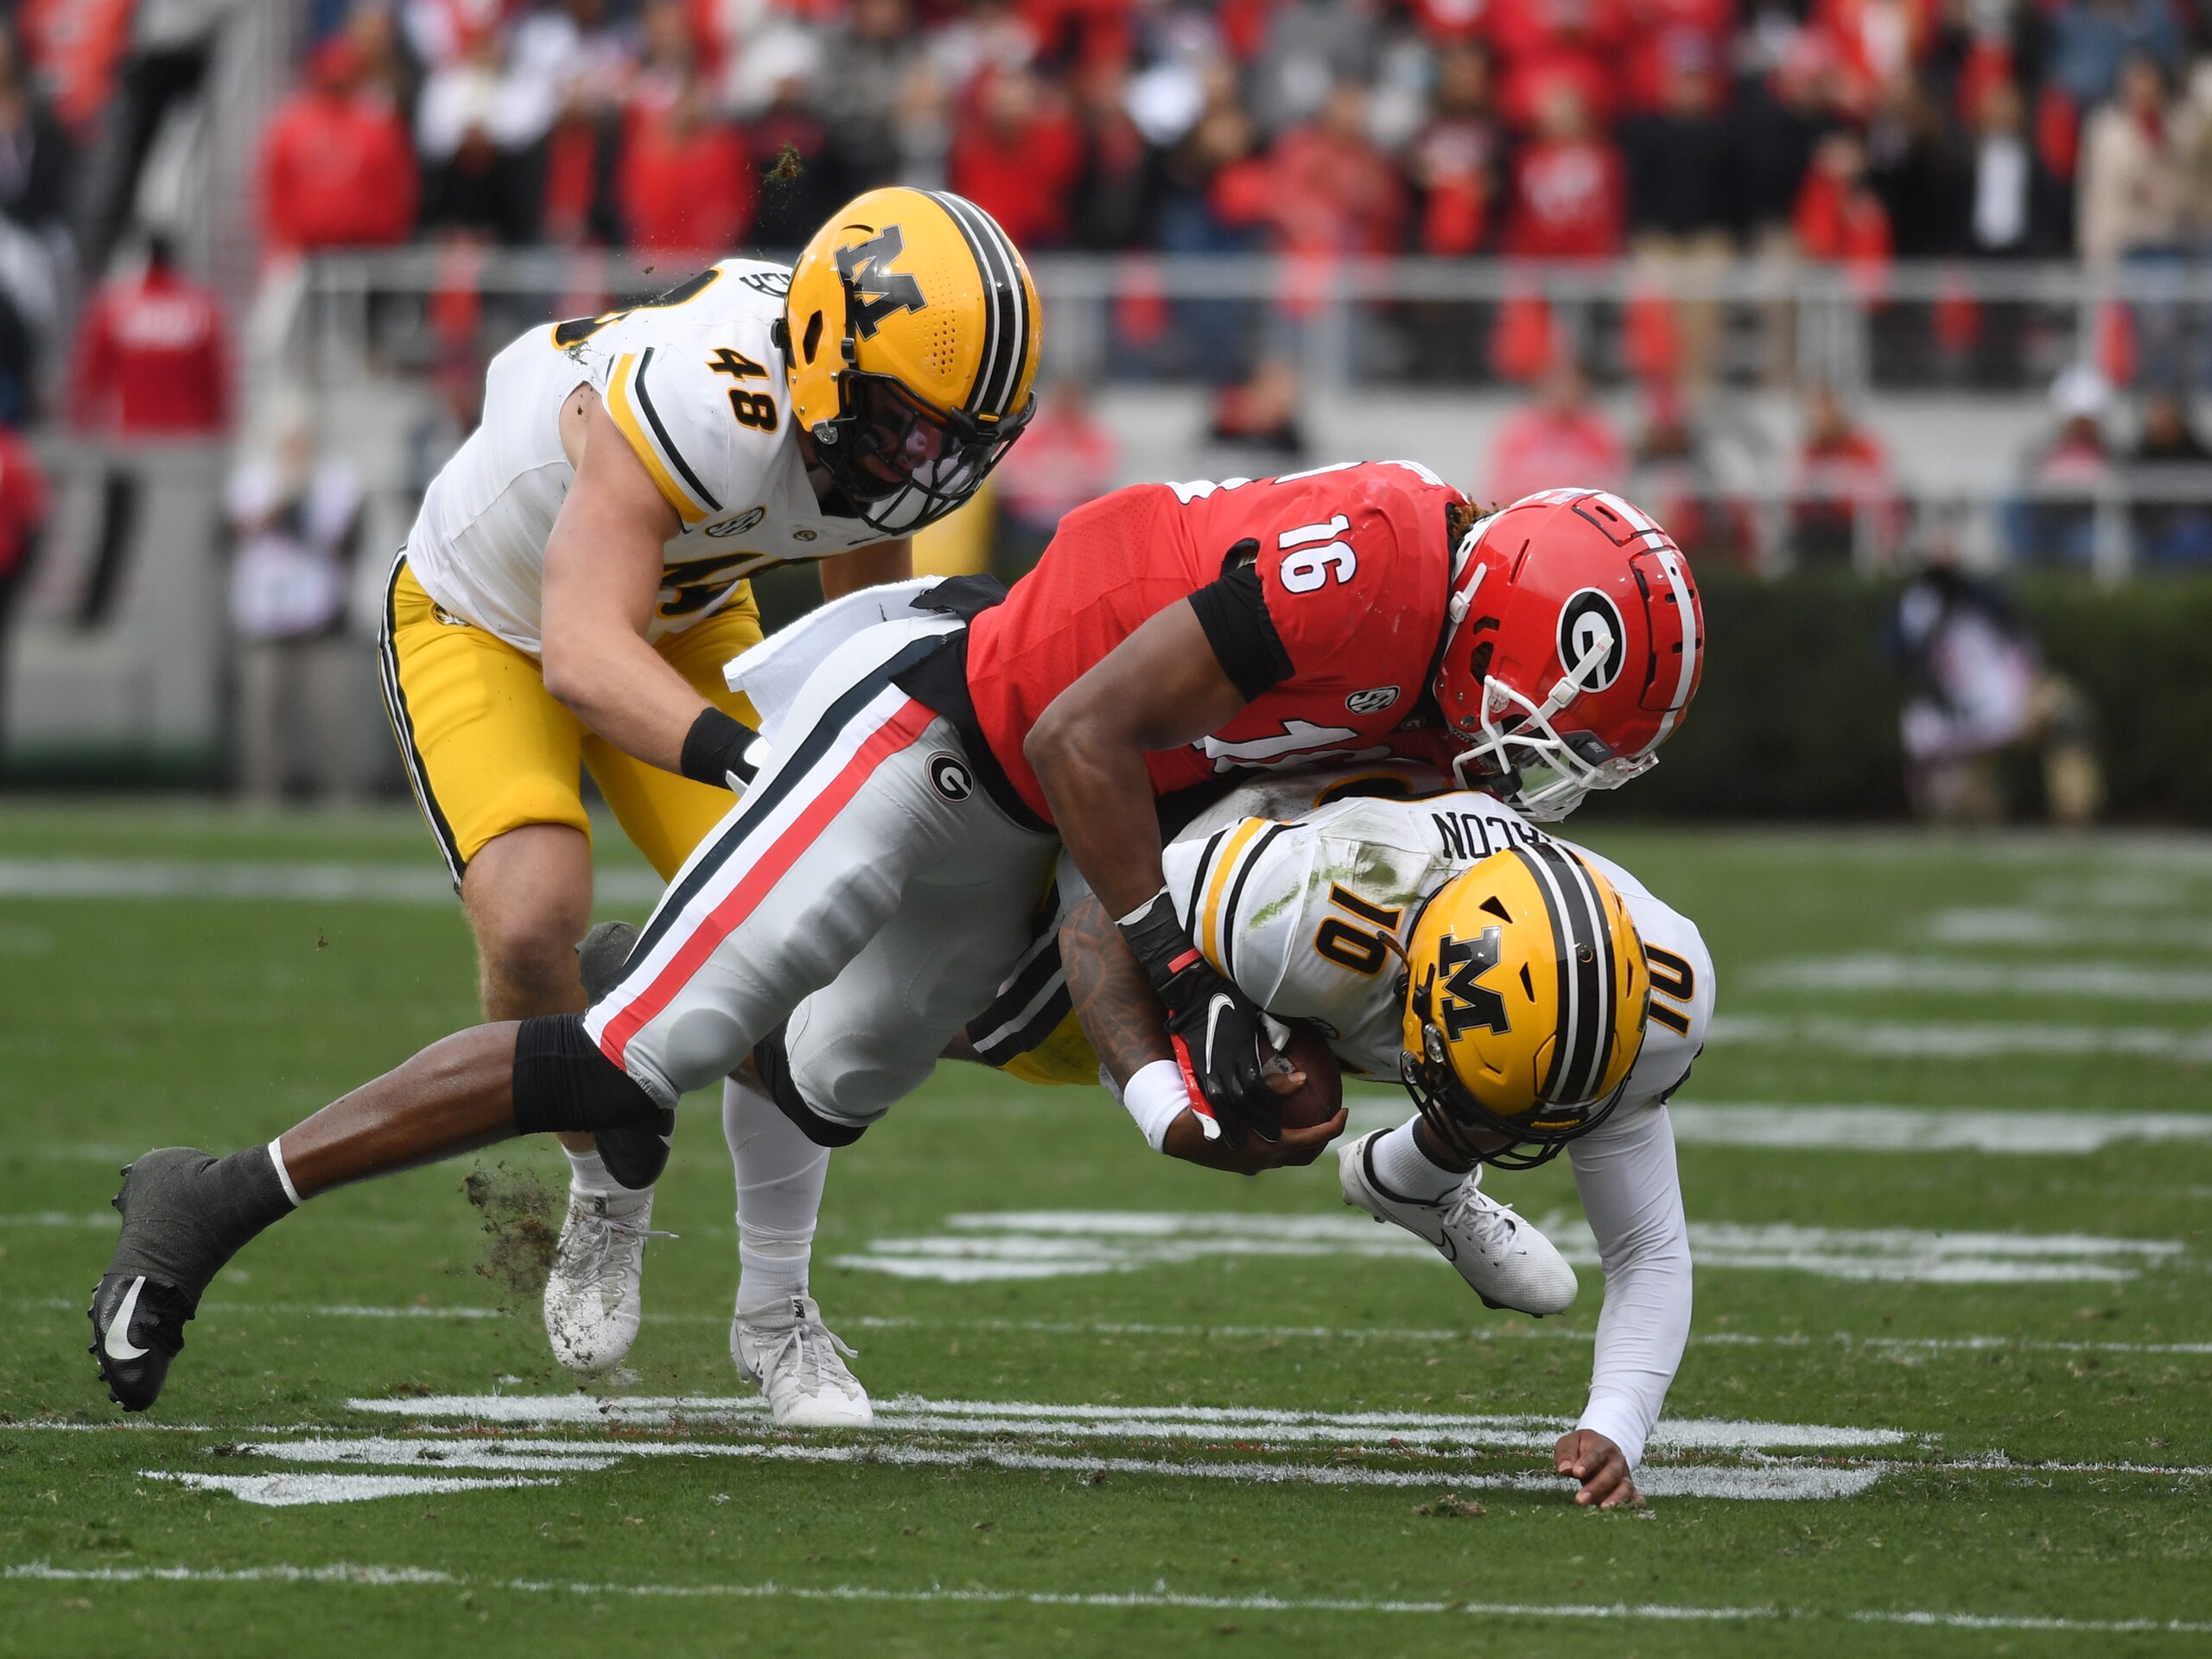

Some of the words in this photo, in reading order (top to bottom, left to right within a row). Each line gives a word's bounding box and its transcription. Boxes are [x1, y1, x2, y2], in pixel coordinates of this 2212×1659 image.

[834, 223, 928, 342] M
[704, 346, 779, 434] 48
[1279, 513, 1356, 594] 16
[1556, 587, 1627, 693] G
[928, 753, 975, 803] G
[1313, 880, 1403, 978] 10
[1438, 925, 1511, 1042] M
[1643, 940, 1695, 1038] 10
